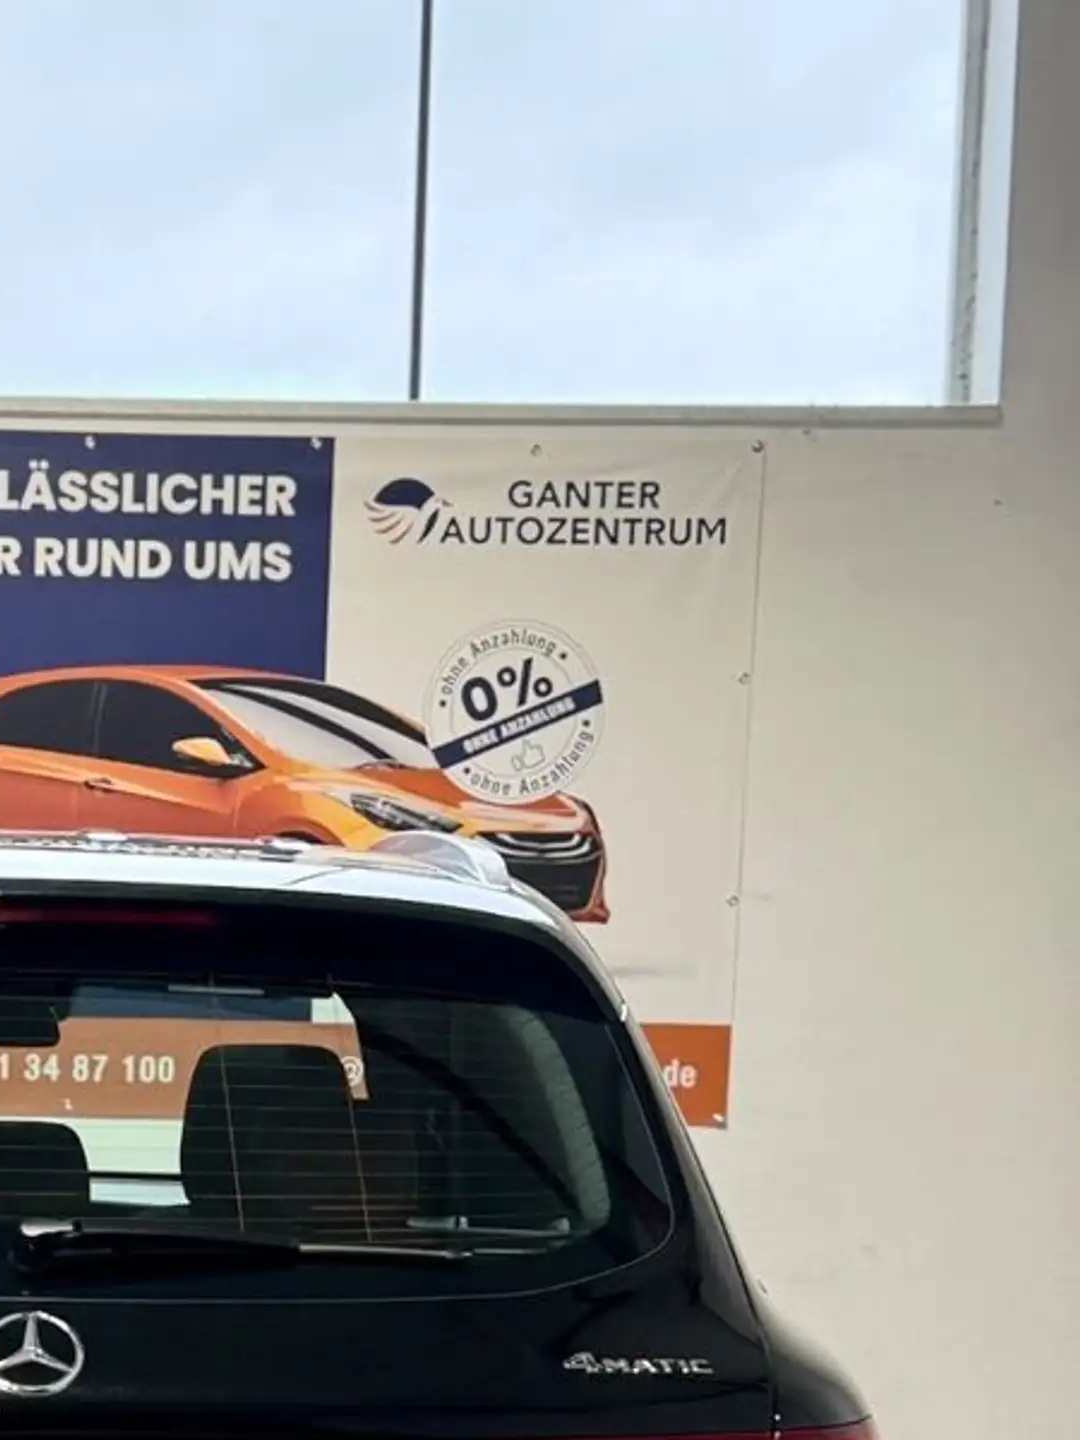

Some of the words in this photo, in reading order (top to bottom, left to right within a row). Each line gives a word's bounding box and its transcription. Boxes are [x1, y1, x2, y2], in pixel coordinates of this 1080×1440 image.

[508, 480, 661, 509] GANTER
[440, 517, 728, 545] AUTOZENTRUM
[34, 537, 172, 579] RUND
[184, 541, 292, 582] UMS
[441, 657, 470, 695] ohne
[470, 628, 558, 658] Anzahlung
[461, 656, 554, 722] 0%
[470, 771, 512, 796] ohne
[519, 731, 595, 795] Anzahlung
[23, 1053, 61, 1082] 34
[72, 1054, 108, 1083] 87
[122, 1055, 176, 1083] 100
[562, 1351, 714, 1375] 4MATIC
